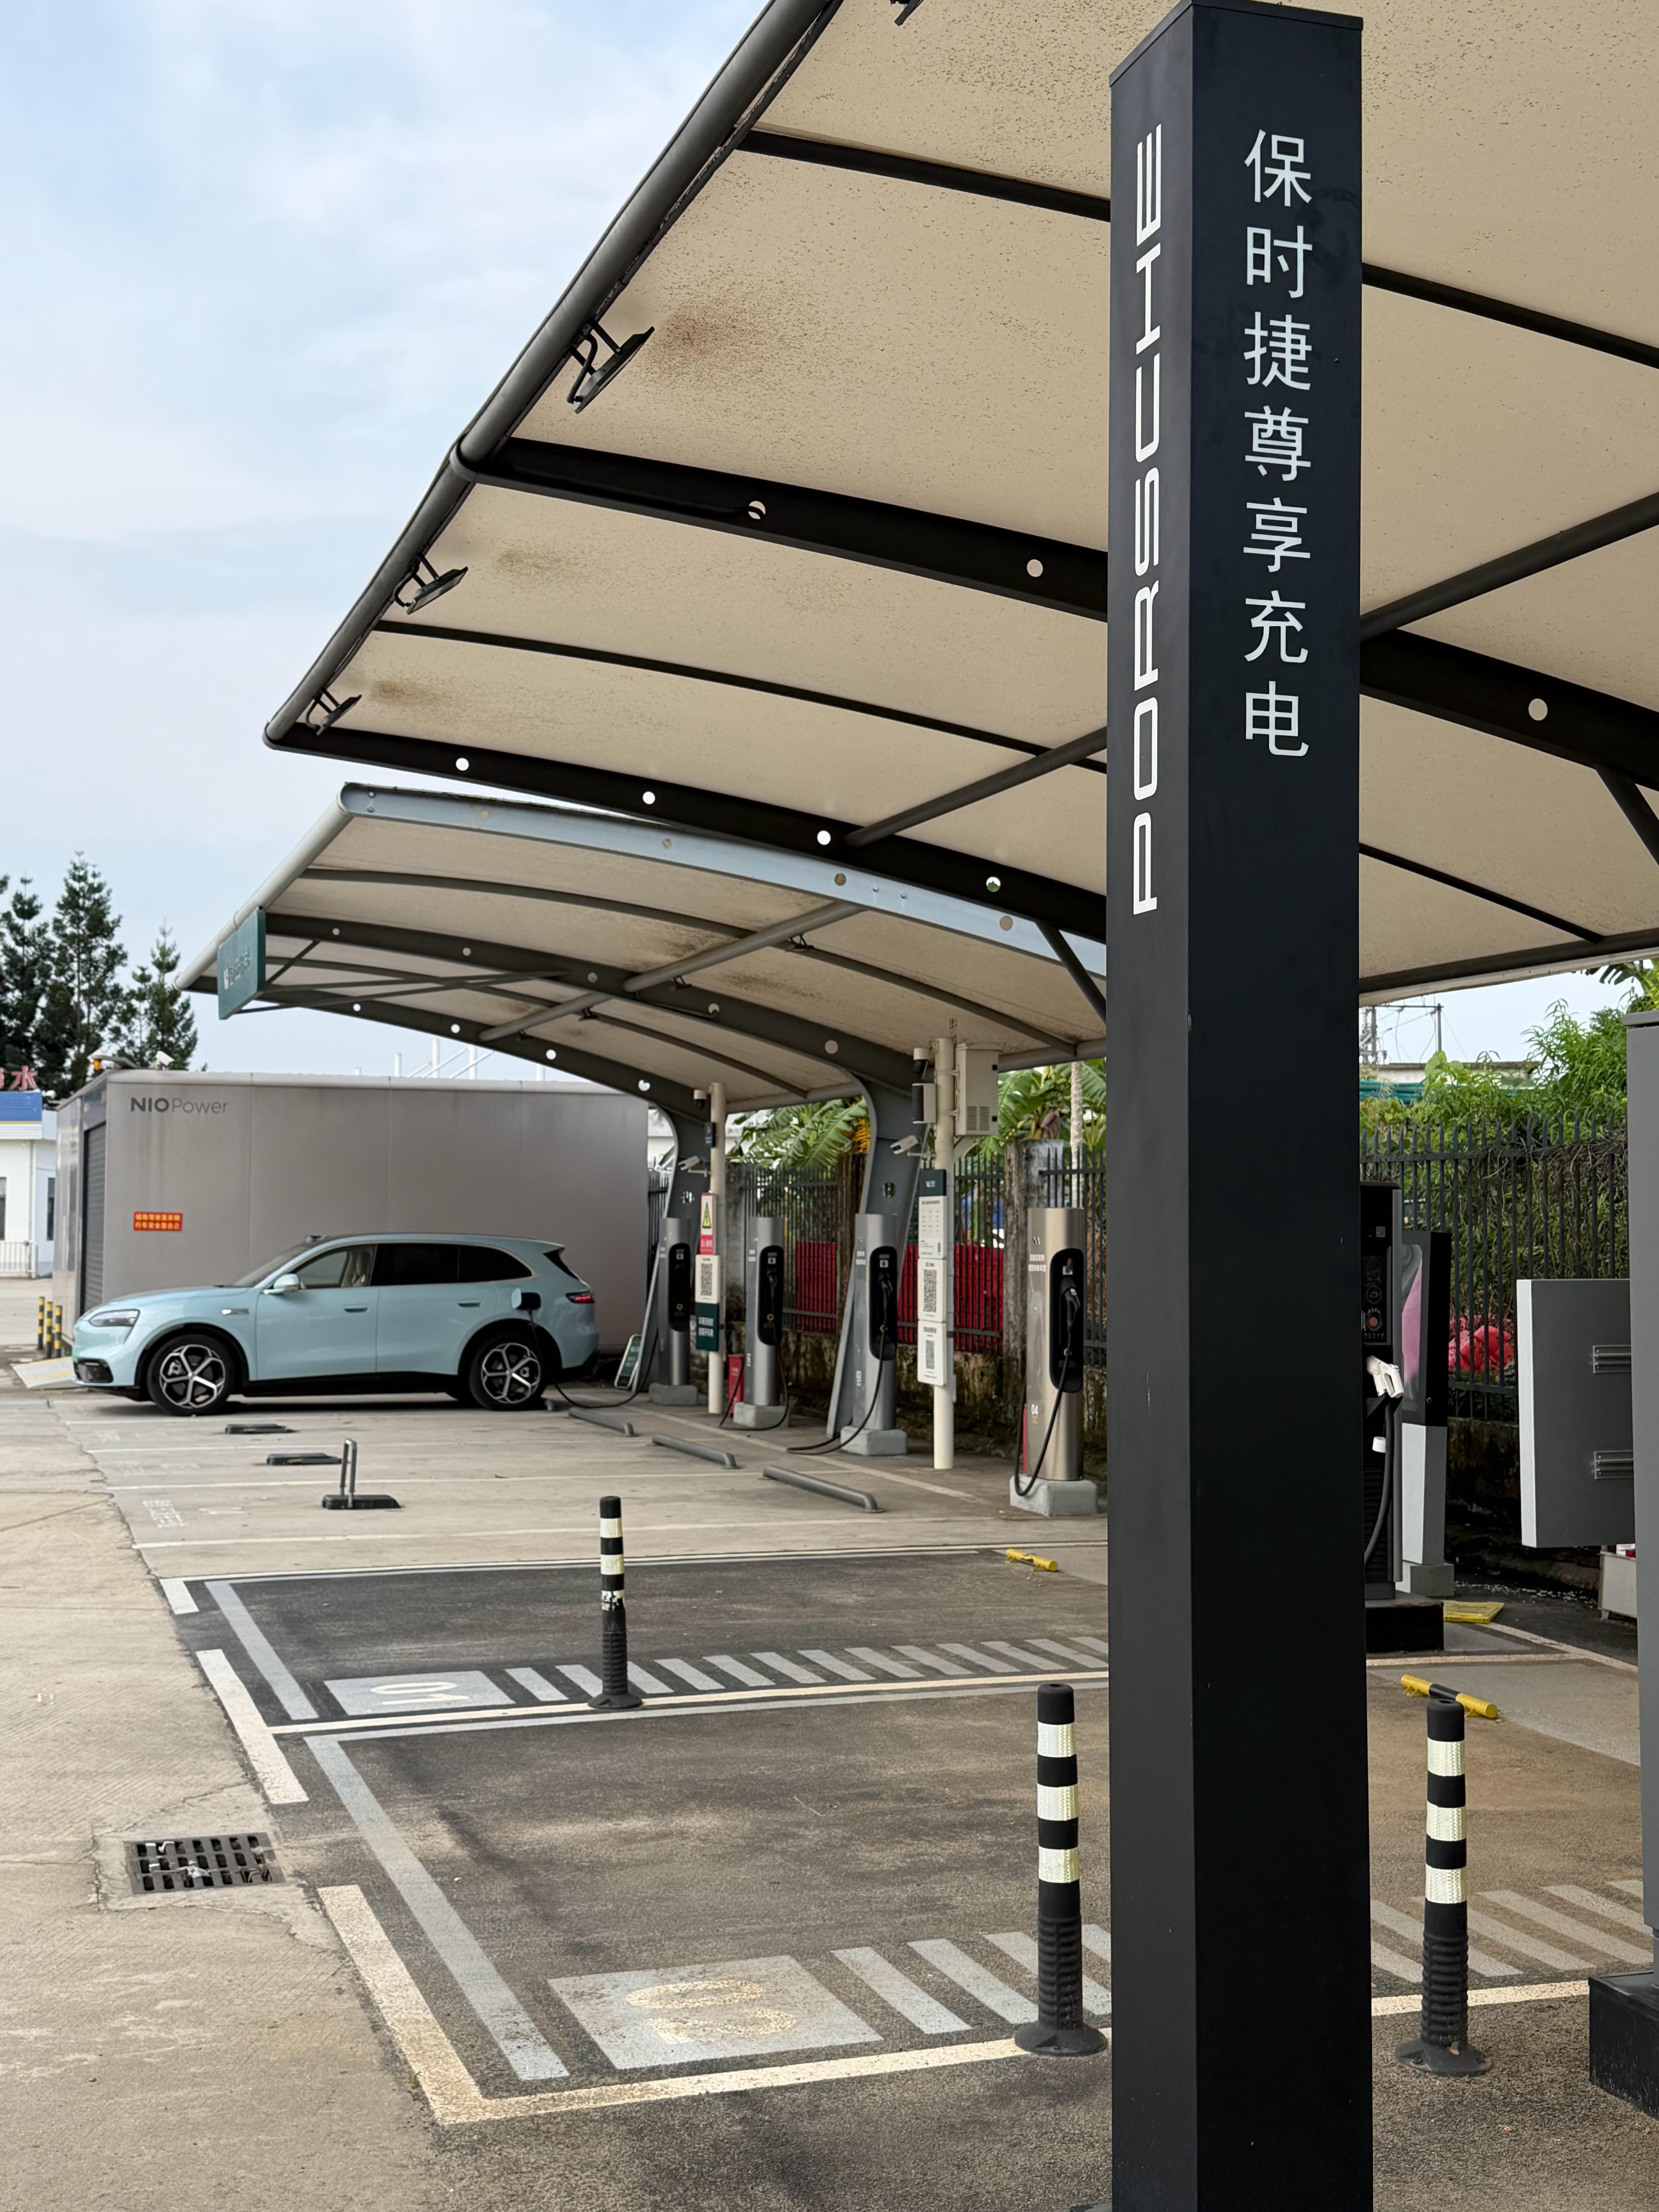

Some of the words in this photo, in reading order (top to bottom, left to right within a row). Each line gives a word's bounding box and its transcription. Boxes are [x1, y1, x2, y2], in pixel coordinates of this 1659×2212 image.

[1133, 124, 1161, 915] PORSCHE
[1243, 129, 1312, 756] 保时捷尊享充电
[0, 1066, 38, 1091] 水
